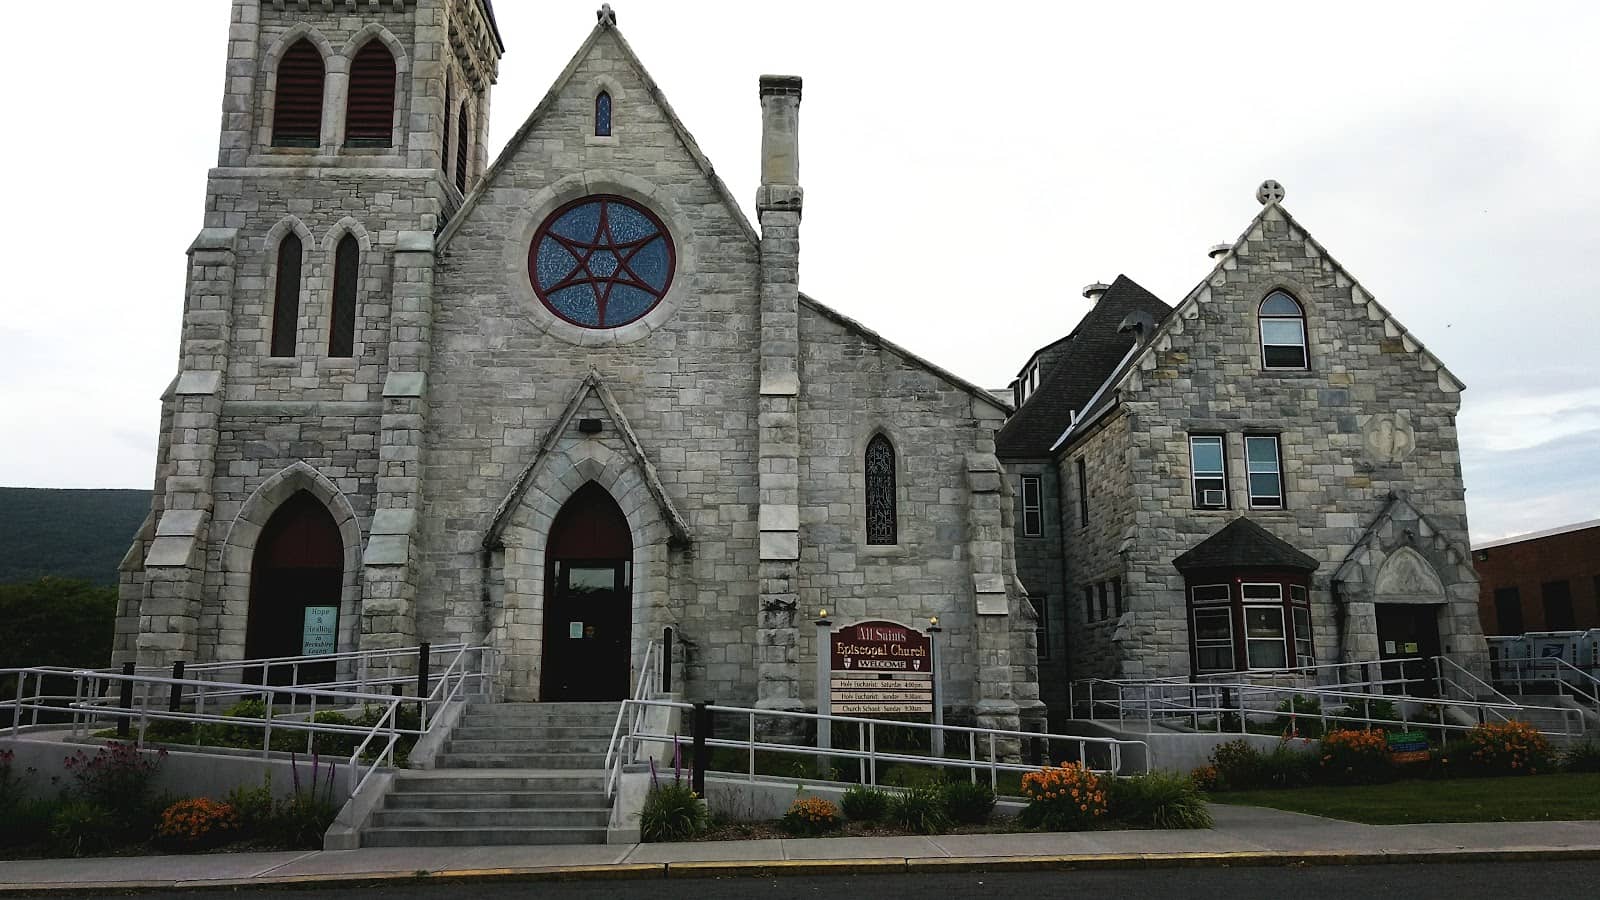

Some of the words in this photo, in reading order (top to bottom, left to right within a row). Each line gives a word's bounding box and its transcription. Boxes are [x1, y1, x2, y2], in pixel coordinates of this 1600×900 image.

[312, 608, 330, 616] Hope
[858, 626, 873, 640] All
[876, 627, 906, 642] Saints
[836, 641, 887, 658] Episcopal
[890, 643, 926, 657] Church
[860, 660, 905, 668] WELCOME
[840, 680, 853, 688] Holy
[842, 704, 861, 712] Church
[883, 704, 901, 713] Sunday
